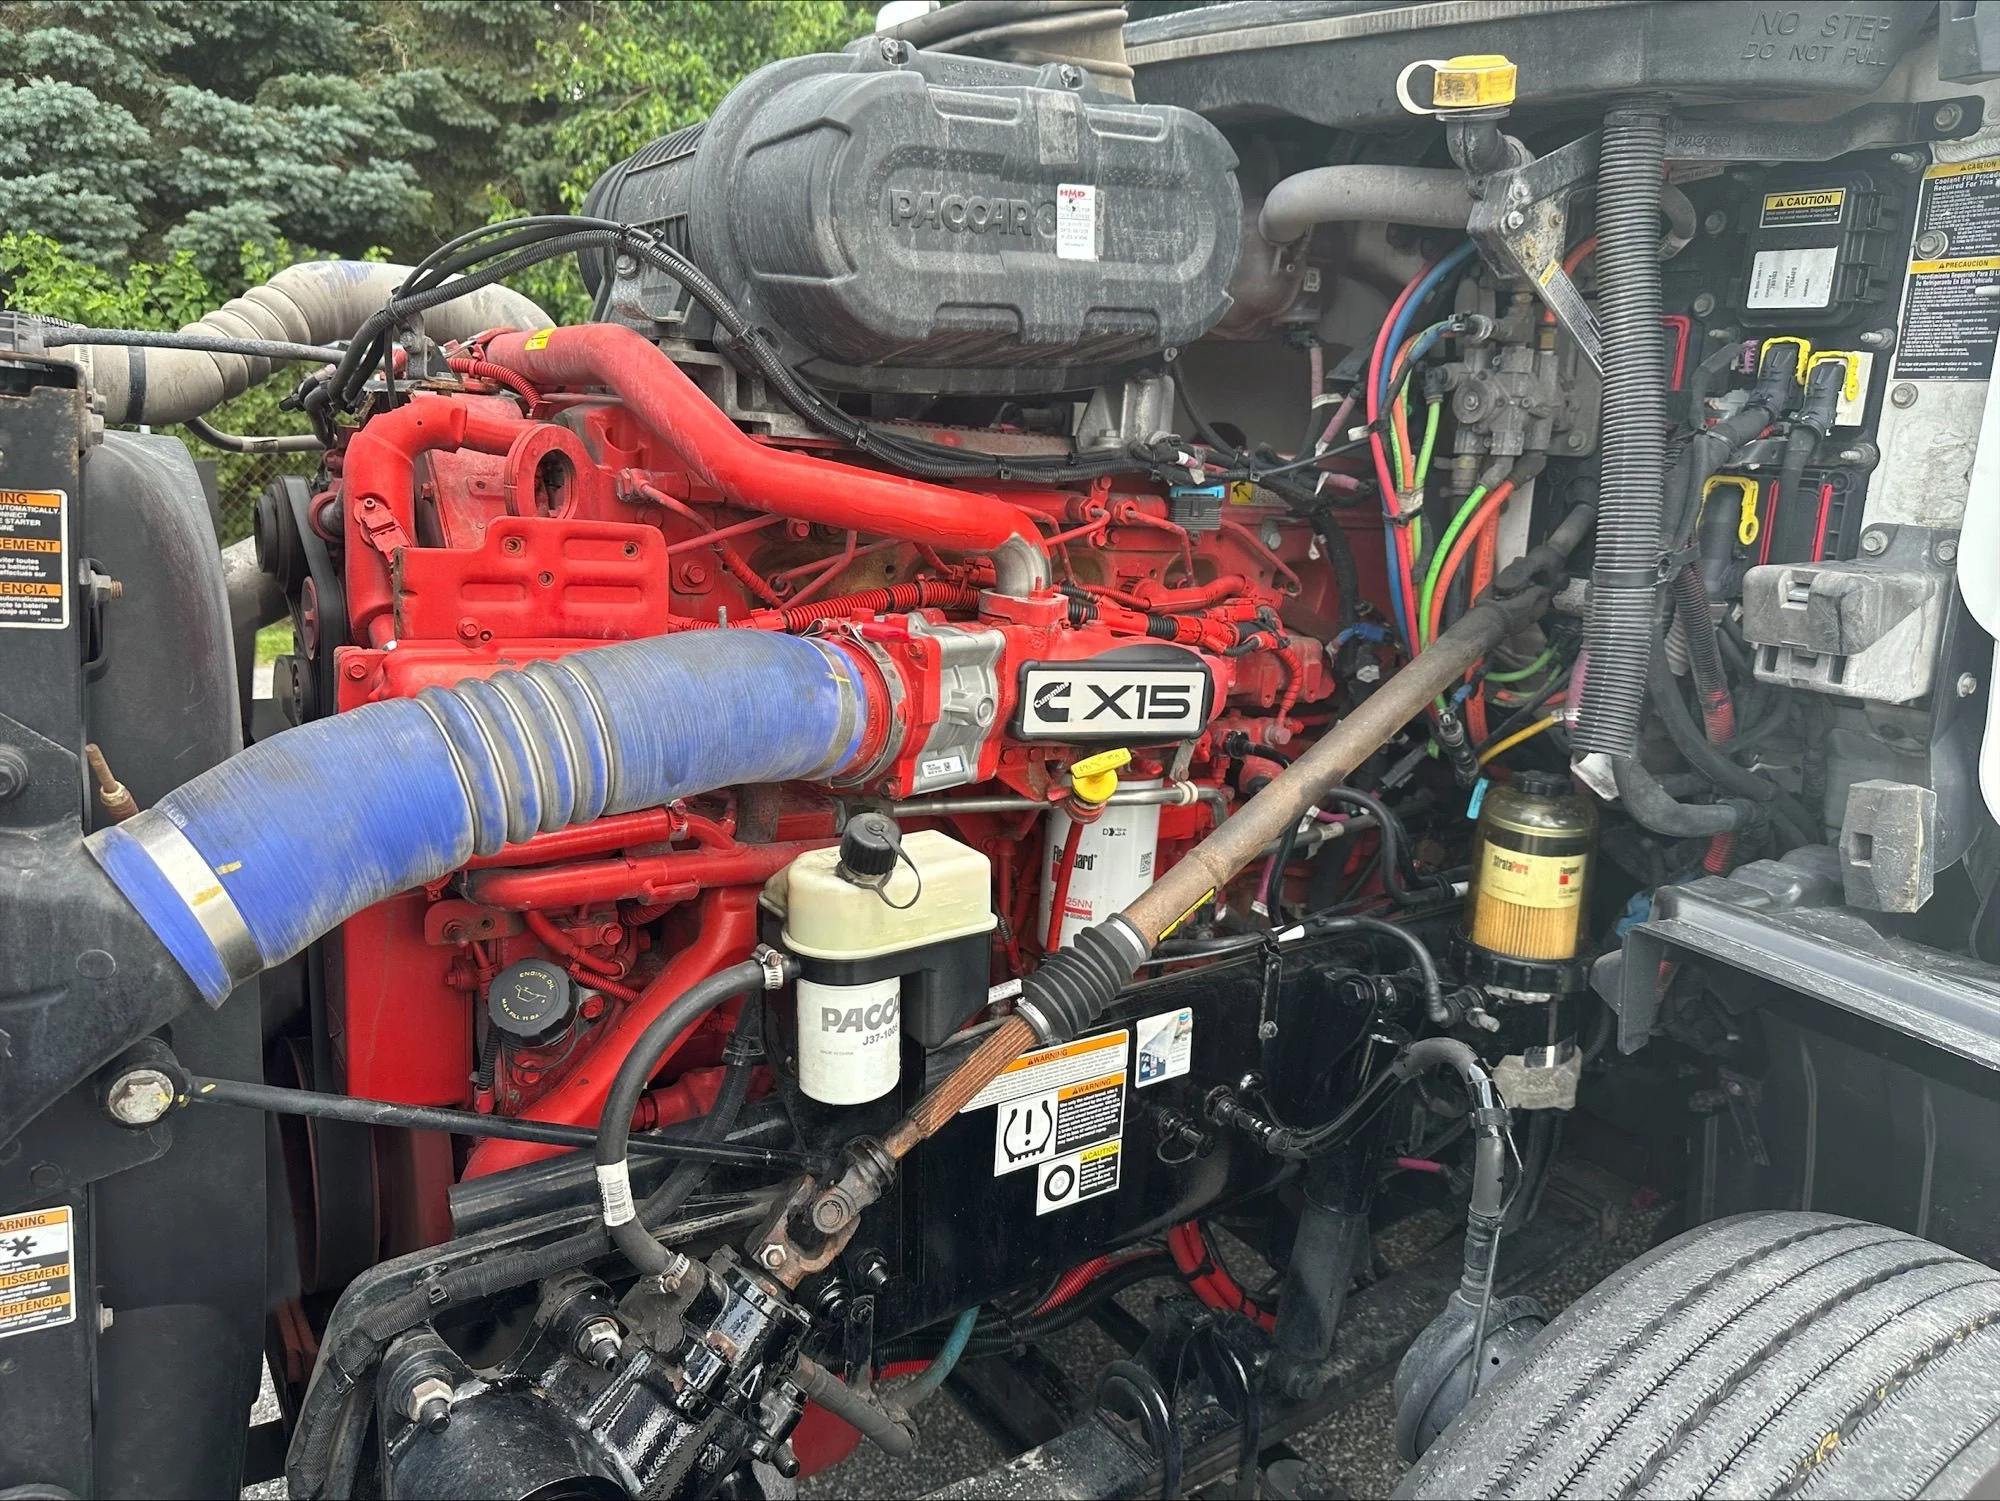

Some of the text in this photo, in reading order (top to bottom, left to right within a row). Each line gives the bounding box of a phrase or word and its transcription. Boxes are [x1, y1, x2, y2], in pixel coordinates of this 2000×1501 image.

[1752, 9, 1892, 42] NO STEP
[1741, 43, 1888, 66] DO NOT PULL
[1967, 161, 1997, 171] CAUTION
[1786, 194, 1832, 206] CAUTION
[889, 189, 1032, 236] PACCAR
[0, 505, 60, 515] UTOMATICALLY,
[4, 518, 41, 526] STARTER
[0, 539, 56, 552] EMENT
[1034, 682, 1070, 708] Cummins
[1082, 685, 1190, 719] X15
[1493, 855, 1529, 875] StrataPore
[520, 970, 555, 990] ENGINE OIL
[502, 998, 510, 1012] MAX
[1033, 1049, 1068, 1064] WARNING
[1080, 1079, 1112, 1093] WARNING
[1088, 1145, 1119, 1159] CAUTION
